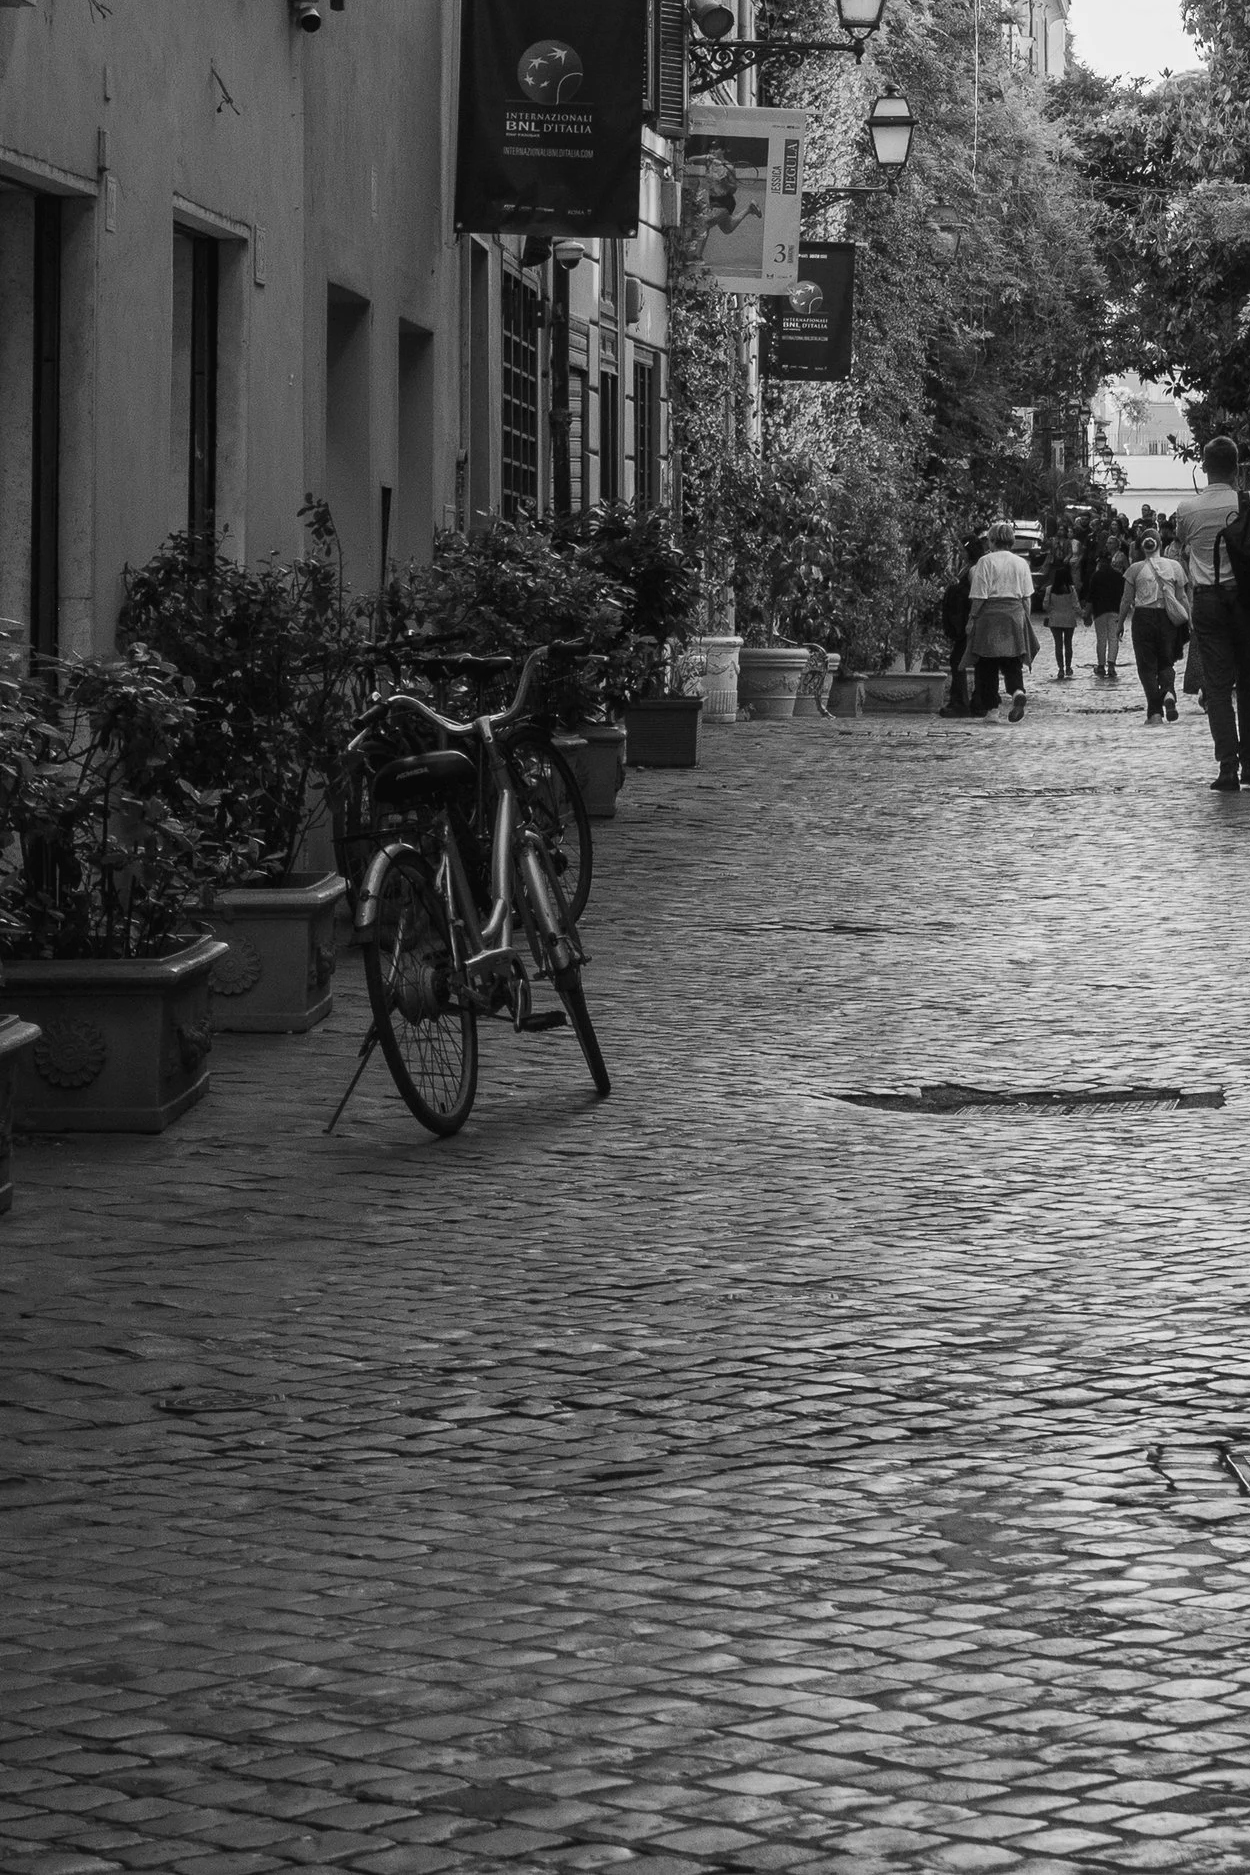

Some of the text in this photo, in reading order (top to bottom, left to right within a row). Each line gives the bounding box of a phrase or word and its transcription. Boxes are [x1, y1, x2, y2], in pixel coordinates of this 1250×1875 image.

[505, 112, 592, 123] INTERNAZIONALI
[505, 120, 592, 134] BNL D'ITALIA
[785, 143, 798, 191] PEGULA
[771, 165, 782, 194] JESSICA
[773, 243, 786, 263] 3
